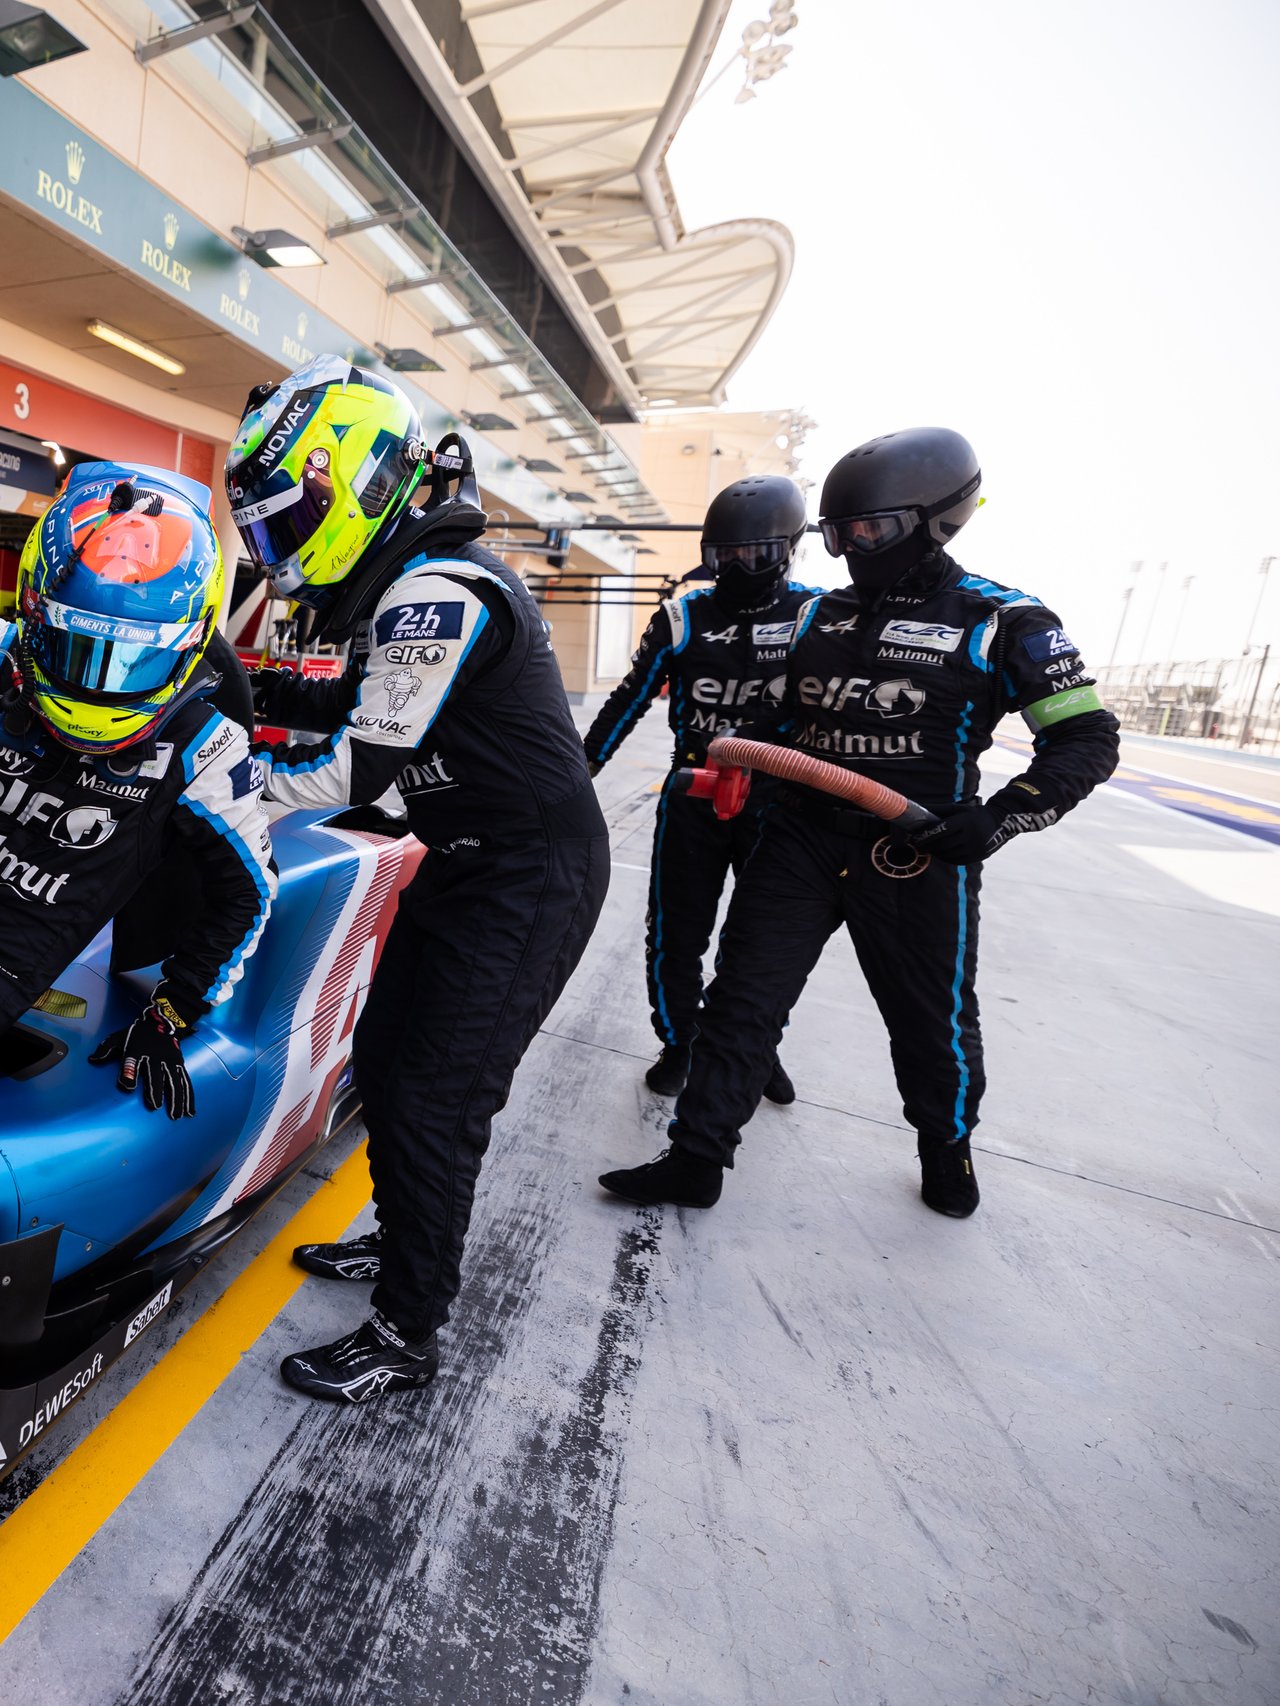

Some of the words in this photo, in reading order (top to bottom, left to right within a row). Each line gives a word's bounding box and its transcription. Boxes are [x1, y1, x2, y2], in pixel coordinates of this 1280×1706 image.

[36, 168, 104, 236] ROLEX
[140, 239, 192, 292] ROLEX
[220, 293, 260, 337] ROLEX
[13, 382, 30, 420] 3
[258, 399, 311, 467] NOVAC
[232, 503, 270, 522] PINE
[885, 594, 926, 605] LPIN
[70, 615, 111, 633] CIMENTS
[112, 626, 126, 638] LA
[127, 629, 156, 642] UNION
[393, 604, 441, 631] 24h
[756, 623, 795, 636] WE
[889, 623, 961, 641] WEC
[391, 630, 405, 639] LE
[405, 629, 437, 639] MANS
[385, 644, 424, 664] elf
[876, 646, 945, 666] Matmut
[691, 677, 764, 706] elf
[797, 675, 872, 712] elf
[355, 715, 412, 736] NOVAC
[794, 721, 926, 755] Matmut
[196, 724, 235, 763] Sabelt
[396, 751, 454, 790] mut
[129, 1288, 168, 1340] Sabelt
[19, 1352, 104, 1448] DEWESoft
